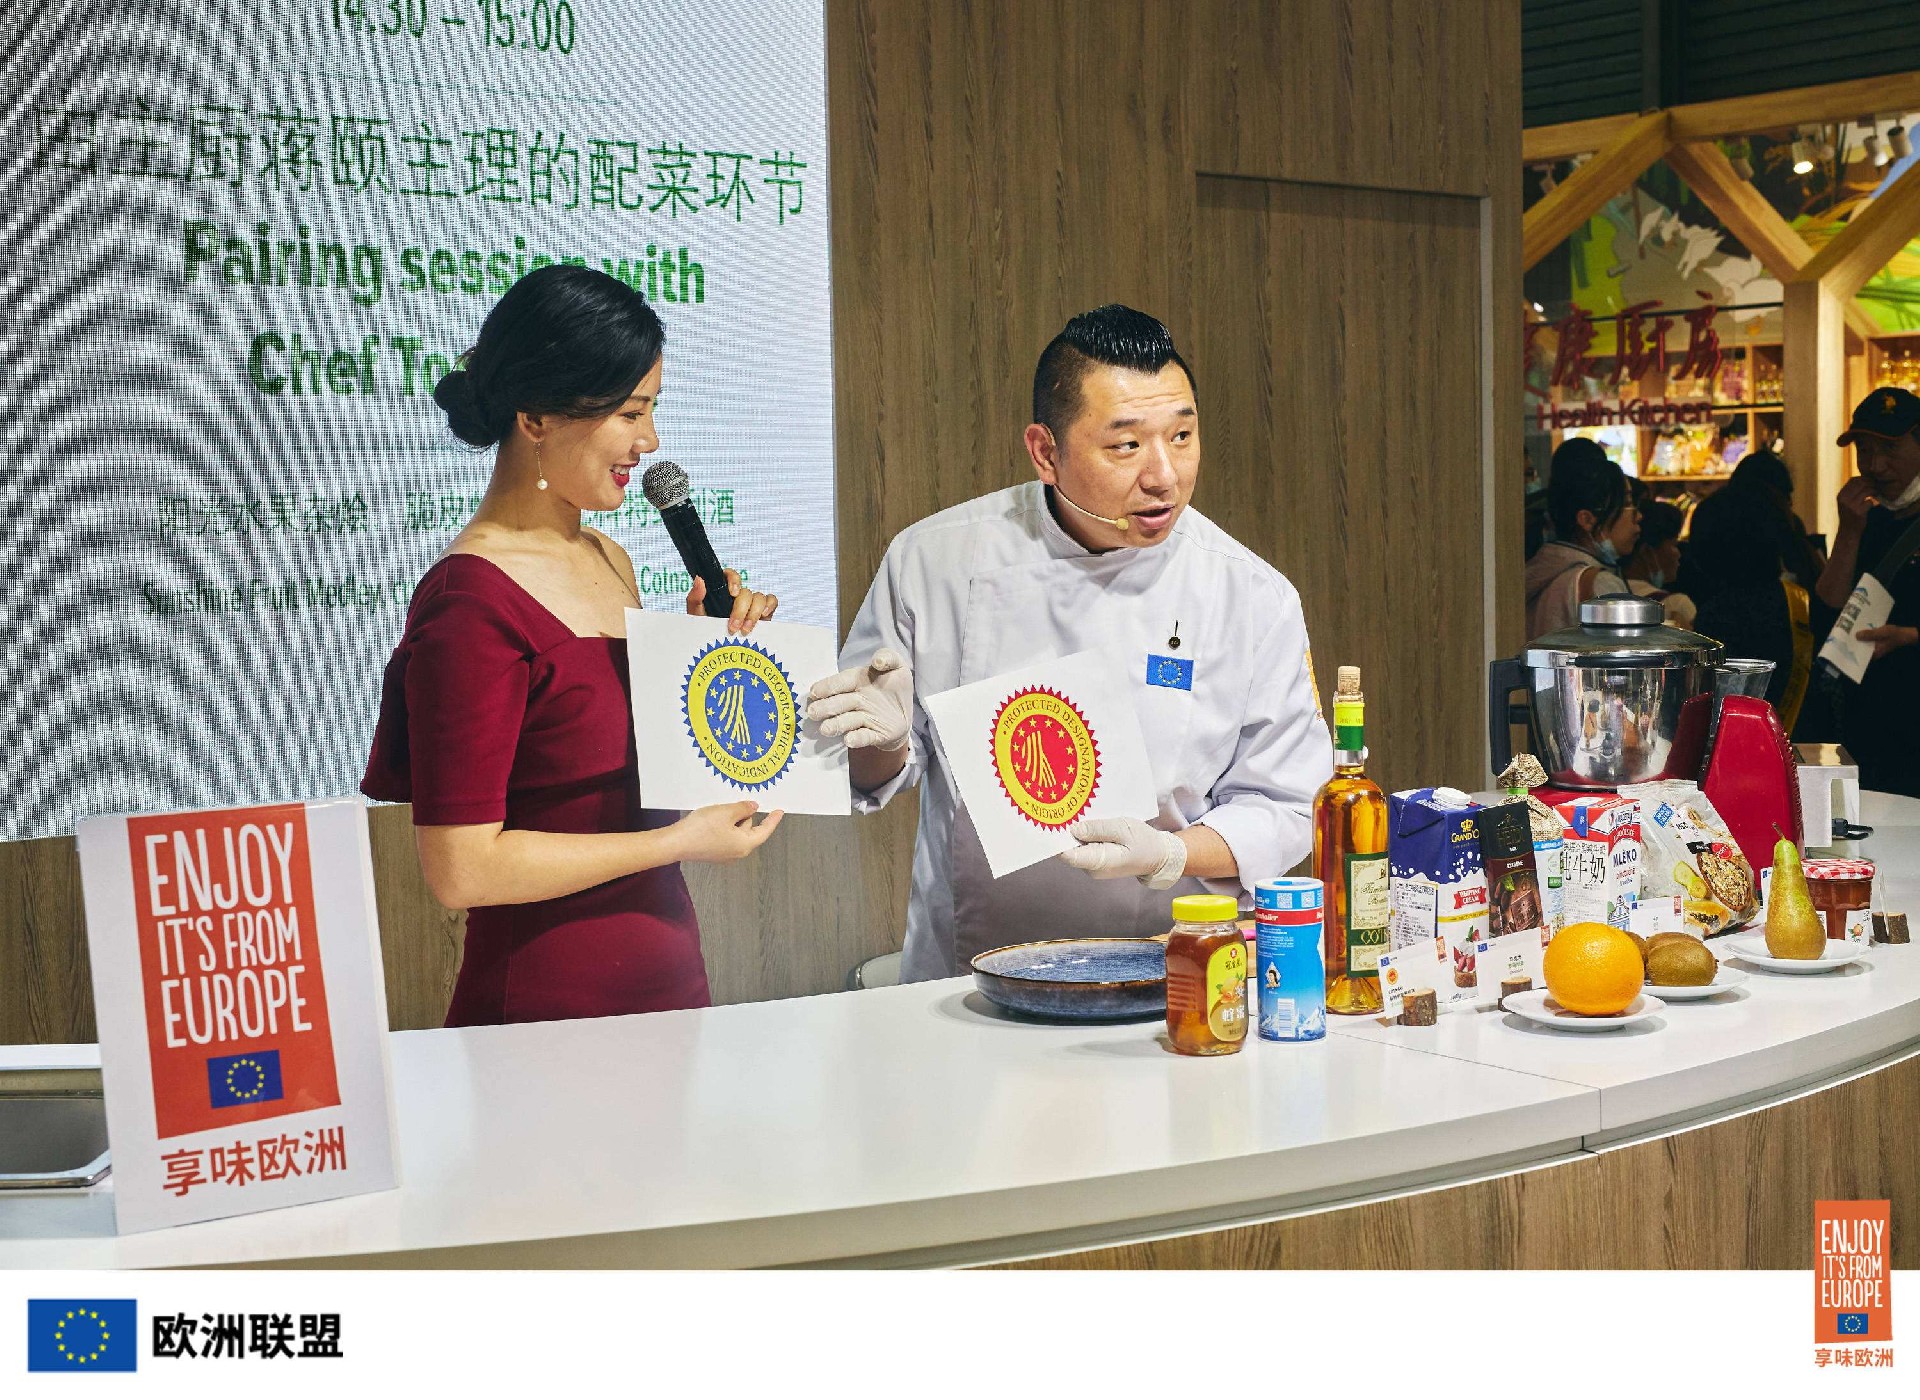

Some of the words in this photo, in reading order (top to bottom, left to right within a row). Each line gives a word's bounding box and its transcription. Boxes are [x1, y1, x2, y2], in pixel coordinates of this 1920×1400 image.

[477, 0, 575, 54] 15:00
[183, 219, 382, 308] Pairing
[400, 237, 586, 296] sessi
[250, 331, 381, 396] Chef
[1536, 400, 1613, 430] Health
[1619, 398, 1712, 427] Kitchen
[250, 578, 298, 611] Fruit
[698, 651, 762, 683] PROTECTED
[763, 666, 791, 768] GEOGRAPHICAL
[1004, 699, 1060, 730] PROTECTED
[706, 743, 769, 778] INDICATION
[1061, 710, 1090, 798] DESIGNATION
[1030, 802, 1065, 820] ORIGIN
[1066, 796, 1078, 812] OF
[143, 821, 296, 917] ENJOY
[1462, 895, 1480, 905] CREAM
[157, 914, 217, 977] IT'S
[225, 906, 302, 970] FROM
[160, 965, 313, 1049] EUROPE
[161, 1125, 348, 1197] 享味欧洲
